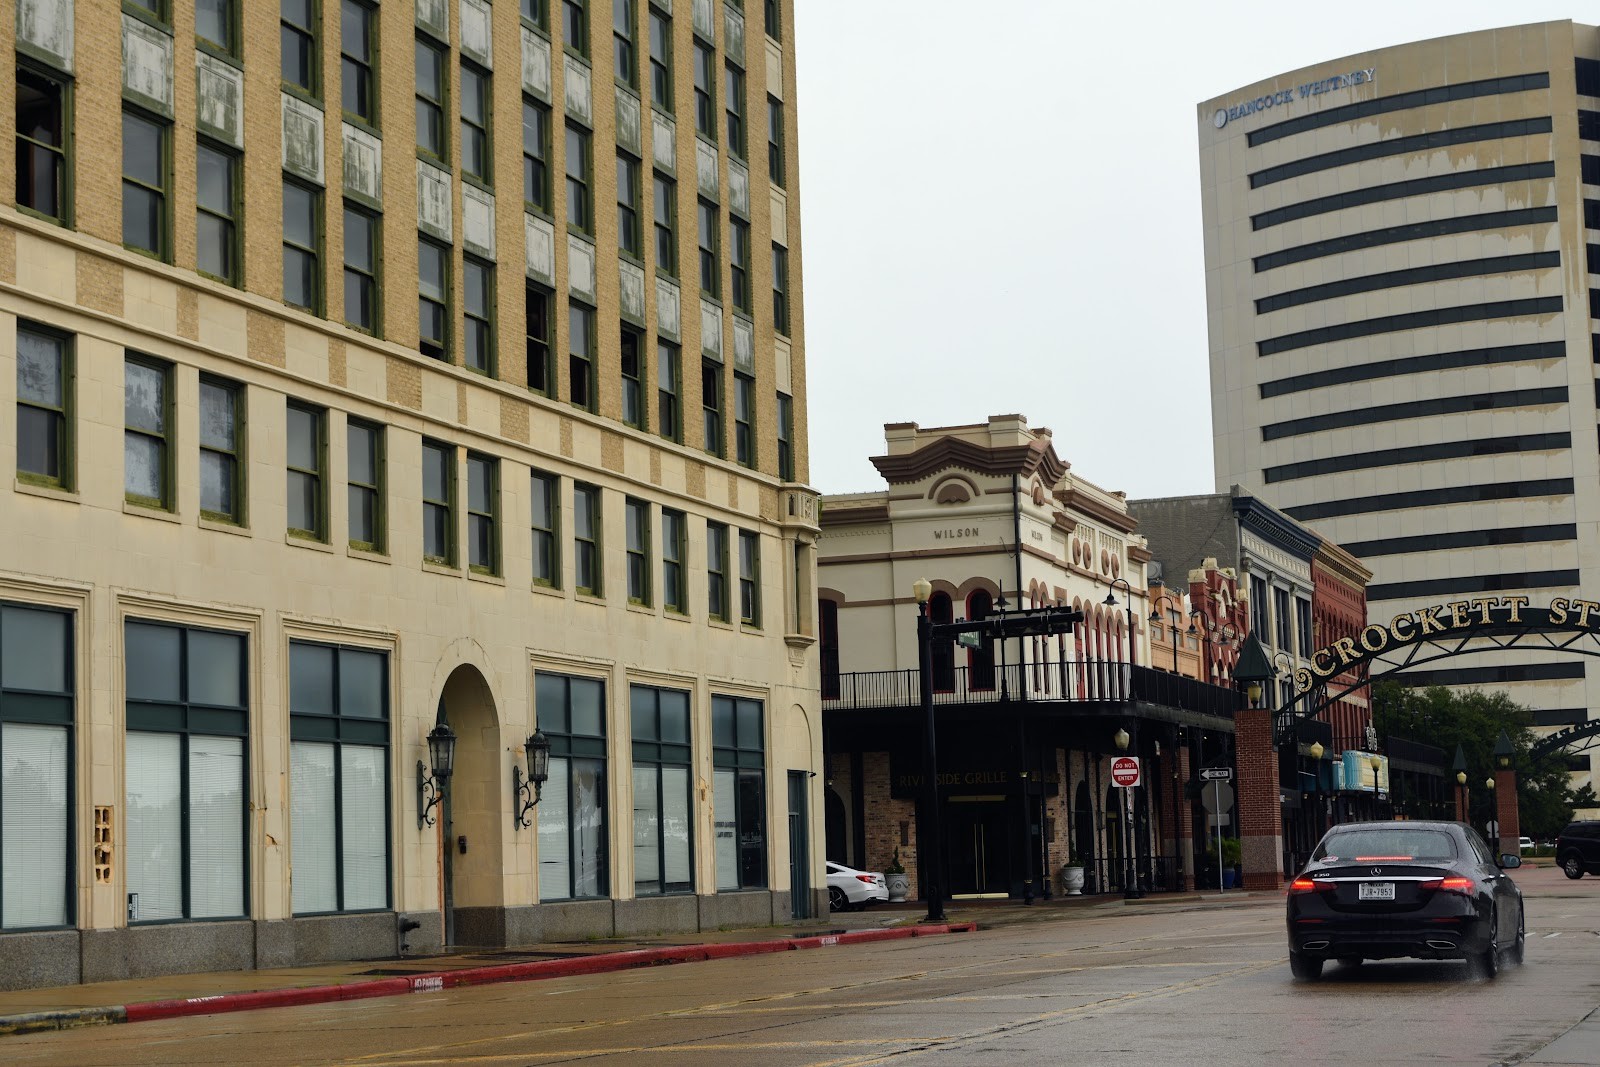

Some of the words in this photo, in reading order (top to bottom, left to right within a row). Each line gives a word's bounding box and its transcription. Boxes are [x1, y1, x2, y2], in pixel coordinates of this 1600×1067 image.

[1228, 88, 1294, 121] HANCOCK
[1297, 68, 1376, 99] WHITNEY
[934, 527, 979, 539] WILSON
[1310, 596, 1529, 677] CROCKETT
[1549, 597, 1600, 628] ST
[899, 772, 961, 787] RIVSIDE
[964, 771, 1008, 785] GRILLE
[415, 978, 422, 987] NO
[422, 976, 443, 987] PARKING
